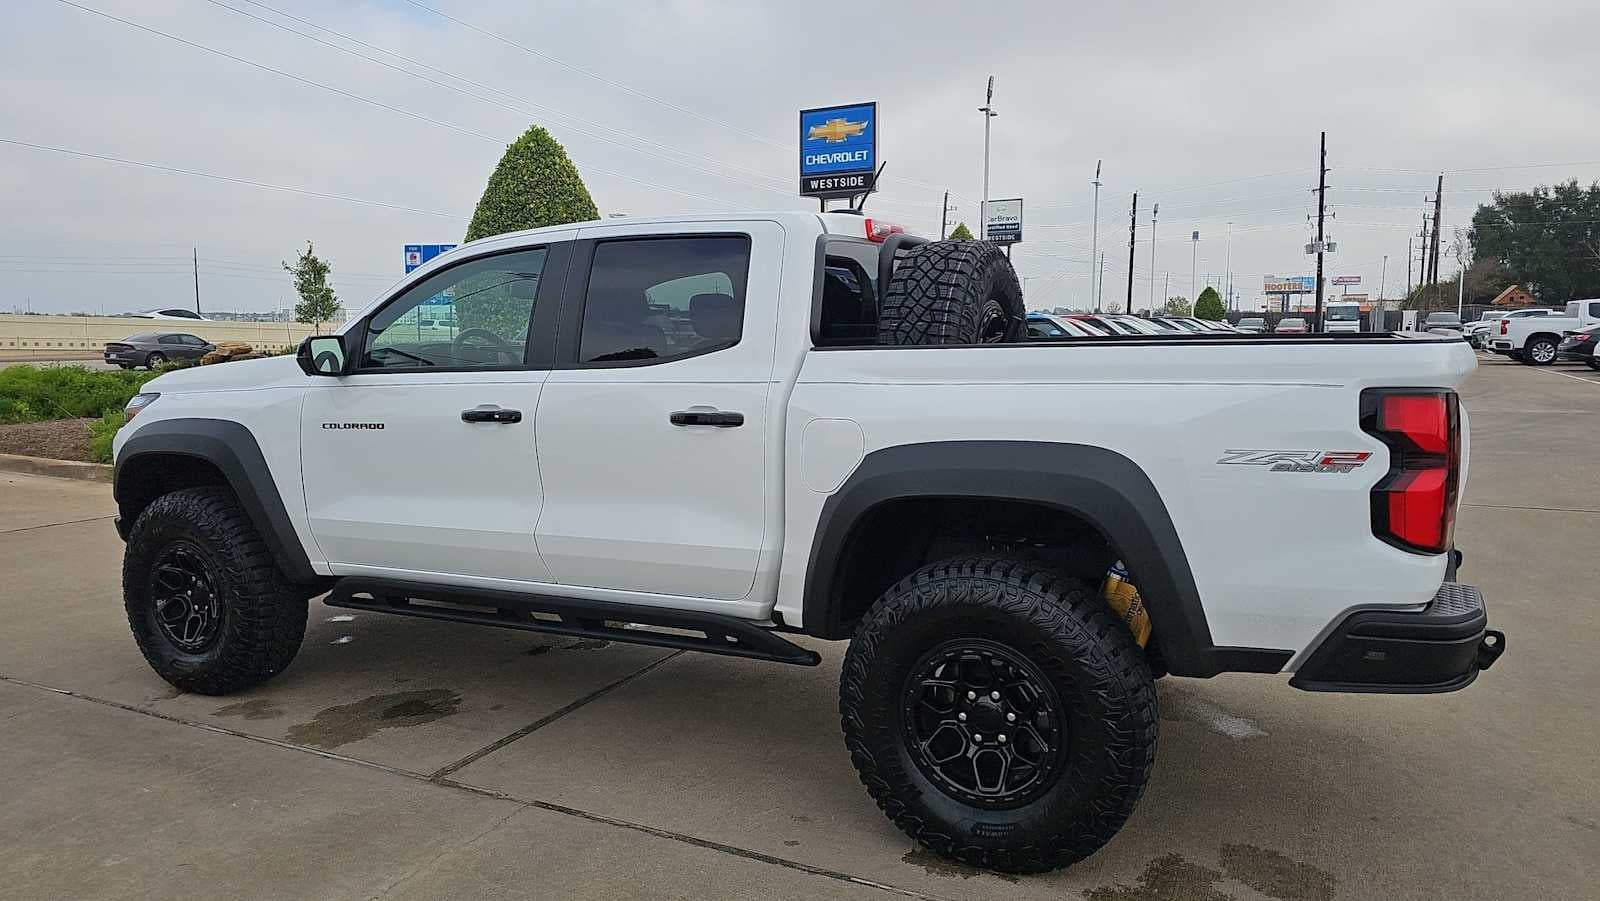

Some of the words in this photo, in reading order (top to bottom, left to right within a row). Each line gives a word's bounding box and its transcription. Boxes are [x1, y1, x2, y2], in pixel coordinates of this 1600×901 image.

[806, 150, 868, 165] CHEVROLET
[810, 176, 864, 189] WESTSIDE
[1216, 449, 1373, 466] ZR2
